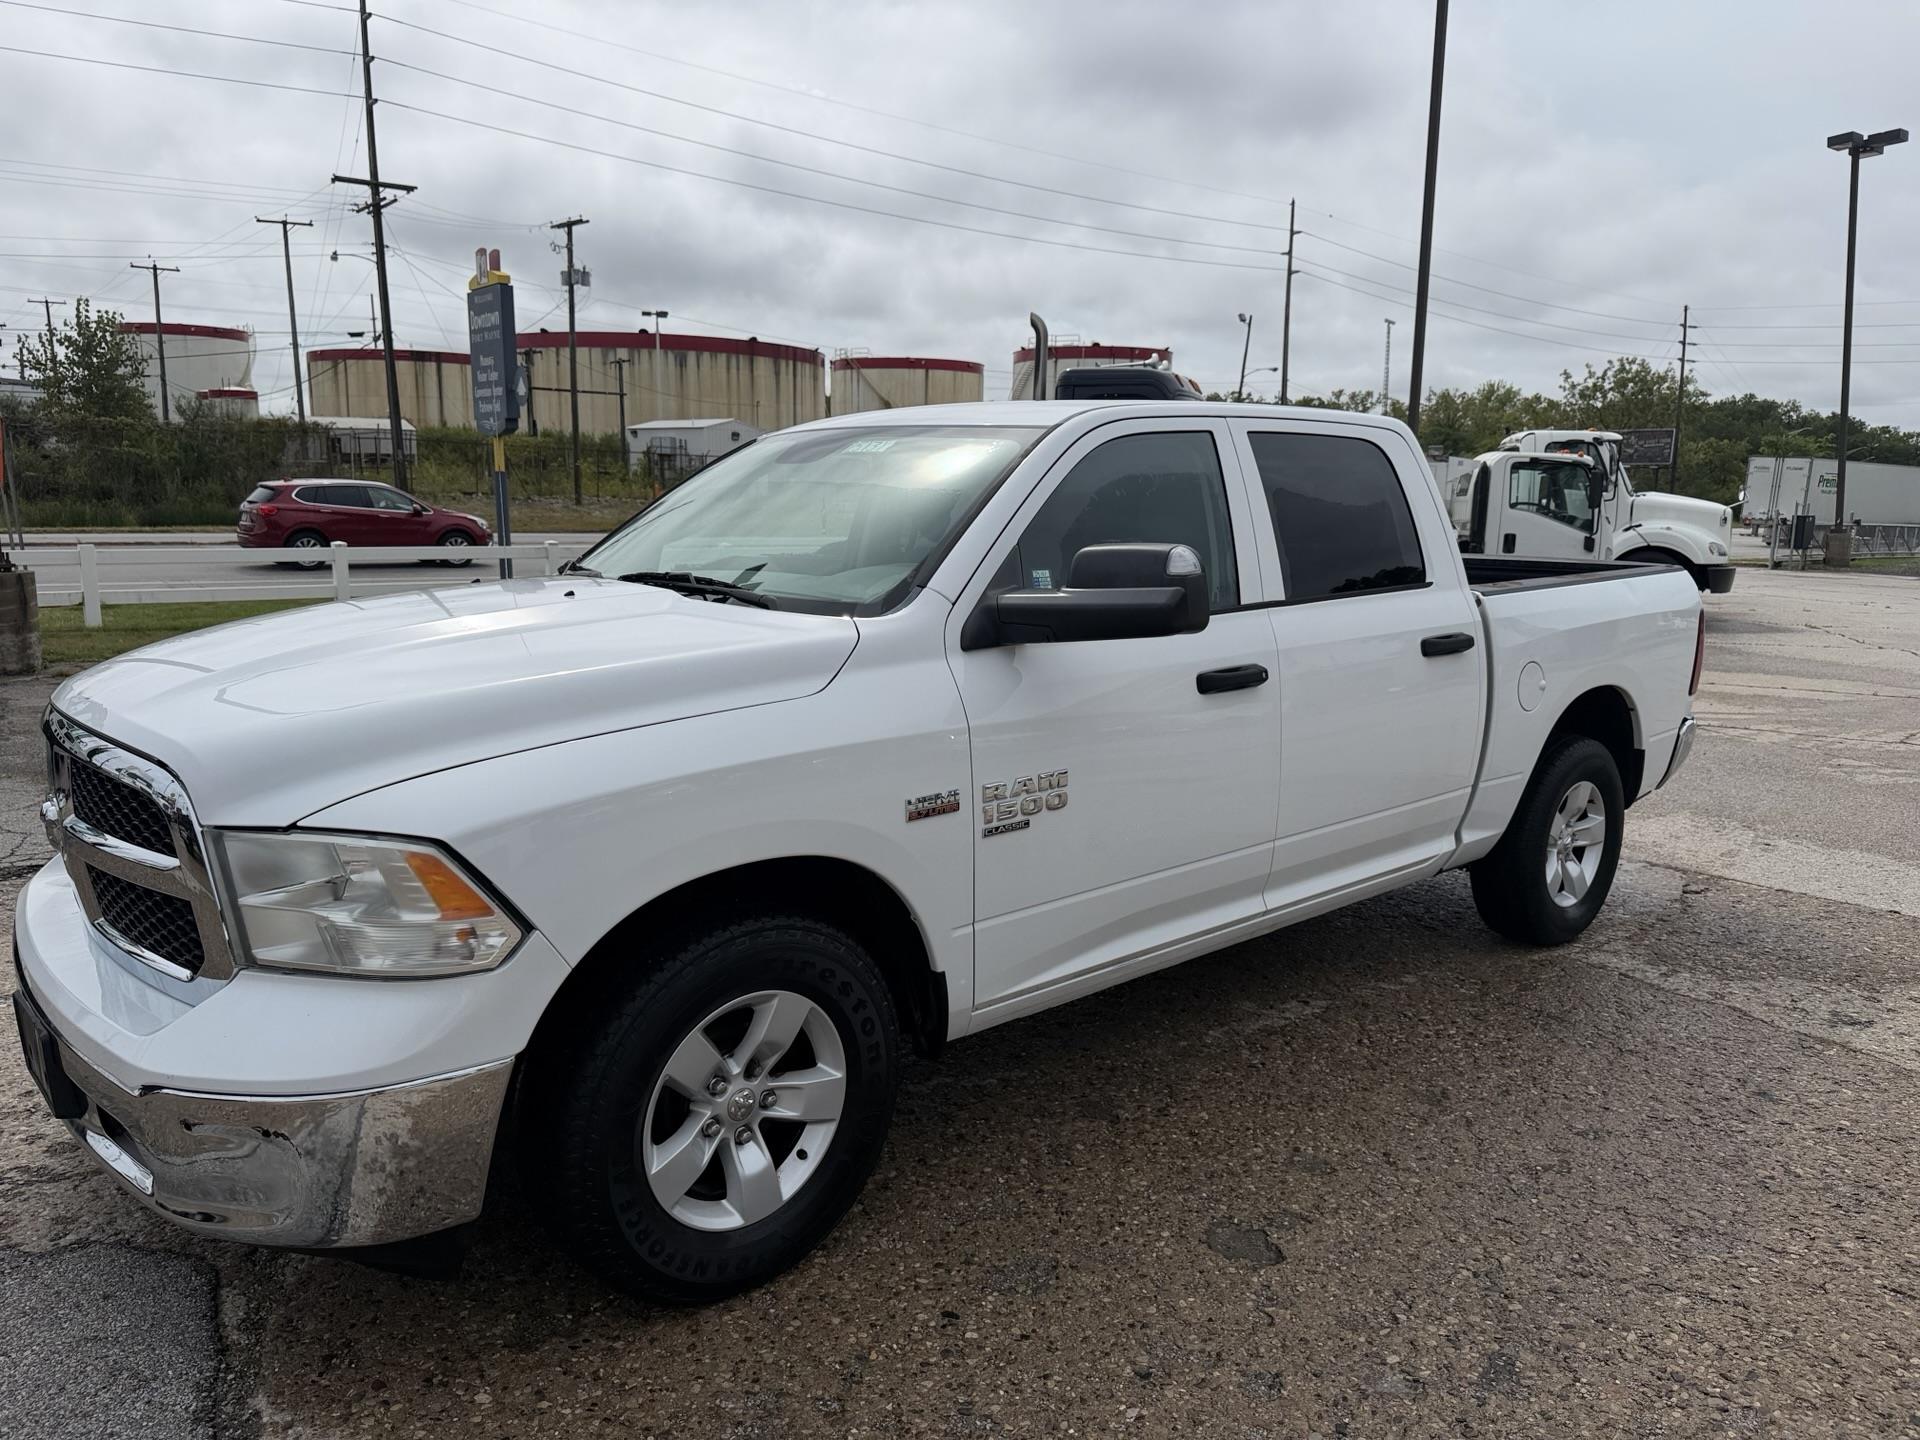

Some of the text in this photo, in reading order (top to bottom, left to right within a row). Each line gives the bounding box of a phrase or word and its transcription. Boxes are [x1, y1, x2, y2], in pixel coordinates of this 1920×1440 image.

[470, 310, 500, 330] Downtown
[1818, 474, 1837, 488] Prem
[982, 768, 1069, 804] RAM
[983, 789, 1069, 825] 1500
[984, 820, 1030, 837] CLASSIC
